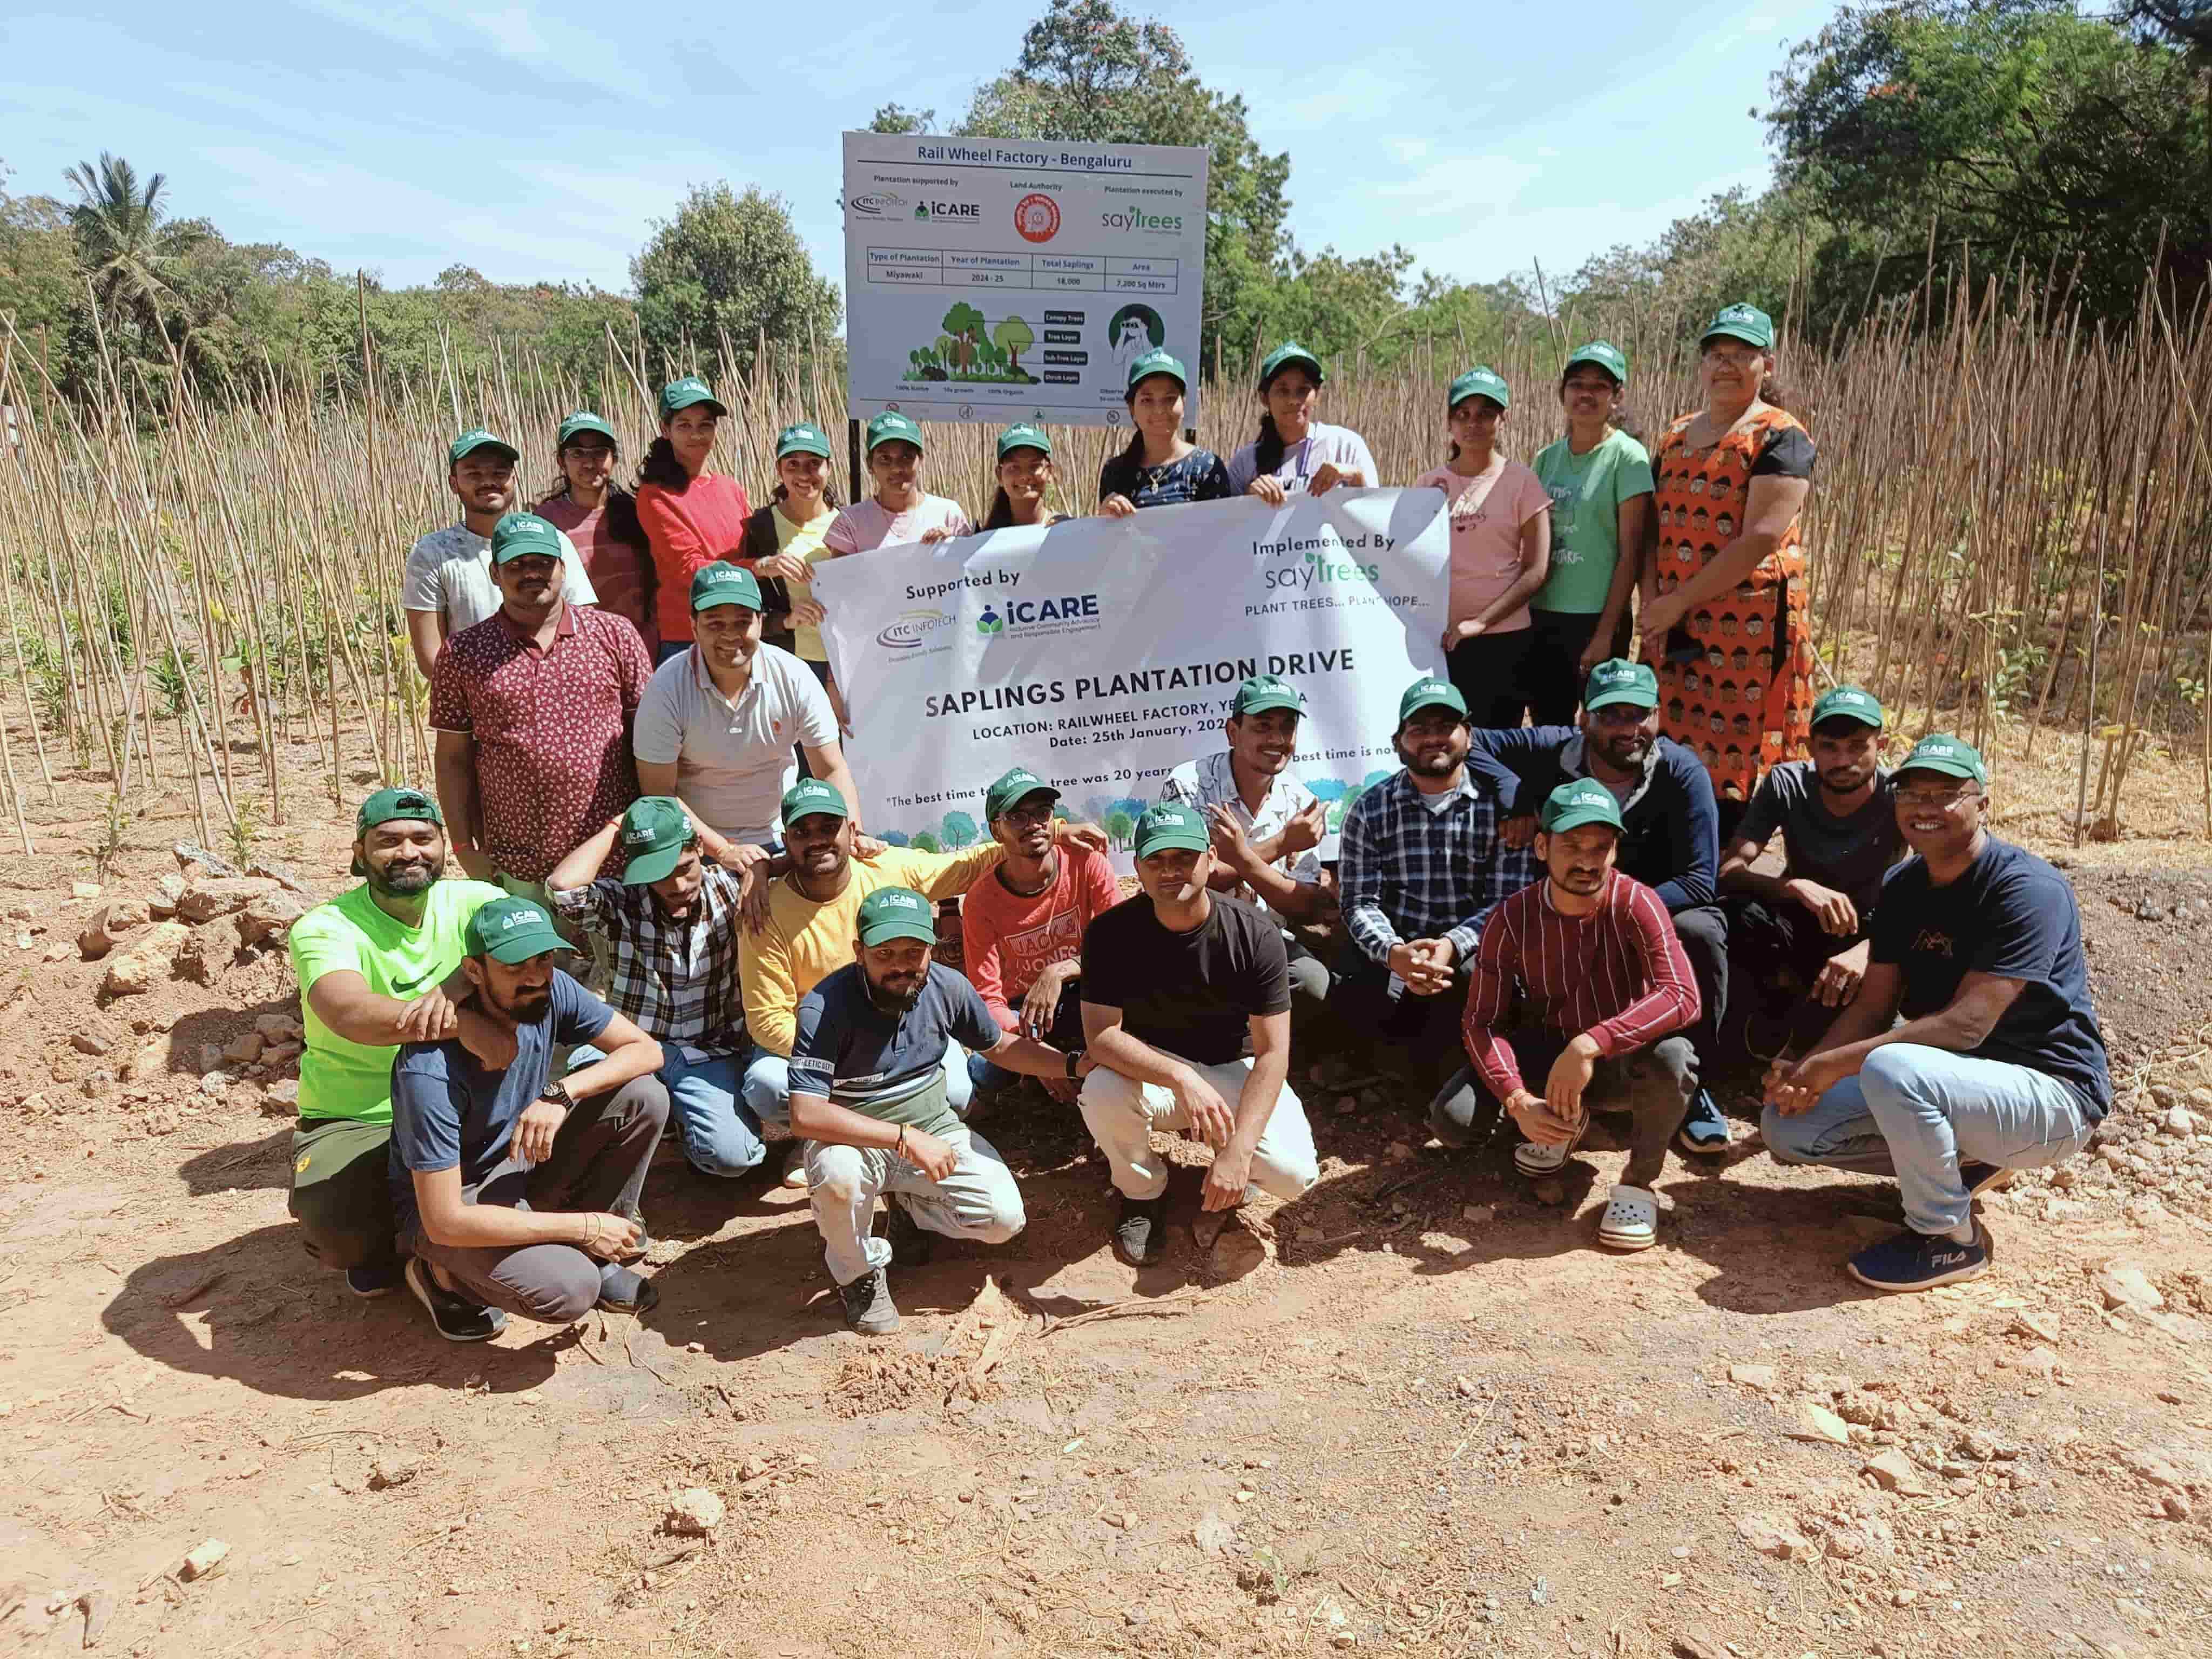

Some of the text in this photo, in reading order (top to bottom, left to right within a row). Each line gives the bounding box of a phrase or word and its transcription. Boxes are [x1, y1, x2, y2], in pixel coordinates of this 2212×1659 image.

[918, 146, 943, 159] Rail
[948, 147, 991, 161] Wheel
[996, 150, 1049, 167] Factory
[1061, 153, 1132, 169] Bengaluru
[873, 175, 959, 187] Plantation supported by
[1009, 181, 1063, 192] Land Authority
[1104, 186, 1183, 198] Plantation executed by
[931, 201, 980, 216] iCARE
[869, 252, 888, 261] Type
[900, 253, 940, 262] Plantation
[950, 255, 969, 264] Year
[980, 257, 1020, 265] Plantation
[1042, 260, 1094, 269] Total Saplings
[886, 271, 923, 280] Miyawaki
[1137, 280, 1147, 290] Sq
[1062, 334, 1077, 342] Layer
[1253, 534, 1395, 556] Implemented By
[906, 569, 1020, 600] Supported by
[1006, 594, 1099, 624] iCARE
[1245, 602, 1287, 616] PLANT
[1348, 596, 1380, 605] PLAN
[893, 615, 956, 637] ITC INFOTECH
[926, 649, 1354, 717] SAPLINGS PLANTATION DRIVE
[973, 703, 1214, 739] LOCATION: RAILWHEEL FACTORY,
[1050, 735, 1087, 748] Date:
[1092, 729, 1124, 743] 25th
[1129, 724, 1192, 739] January,
[915, 793, 941, 804] best
[946, 789, 976, 800] time
[1051, 779, 1077, 787] tree
[1082, 774, 1109, 784] was
[1114, 769, 1131, 780] 20
[1136, 767, 1172, 780] years
[1292, 752, 1320, 762] best
[1326, 748, 1356, 760] time
[1361, 741, 1371, 756] is
[1931, 1250, 1966, 1269] FILA
